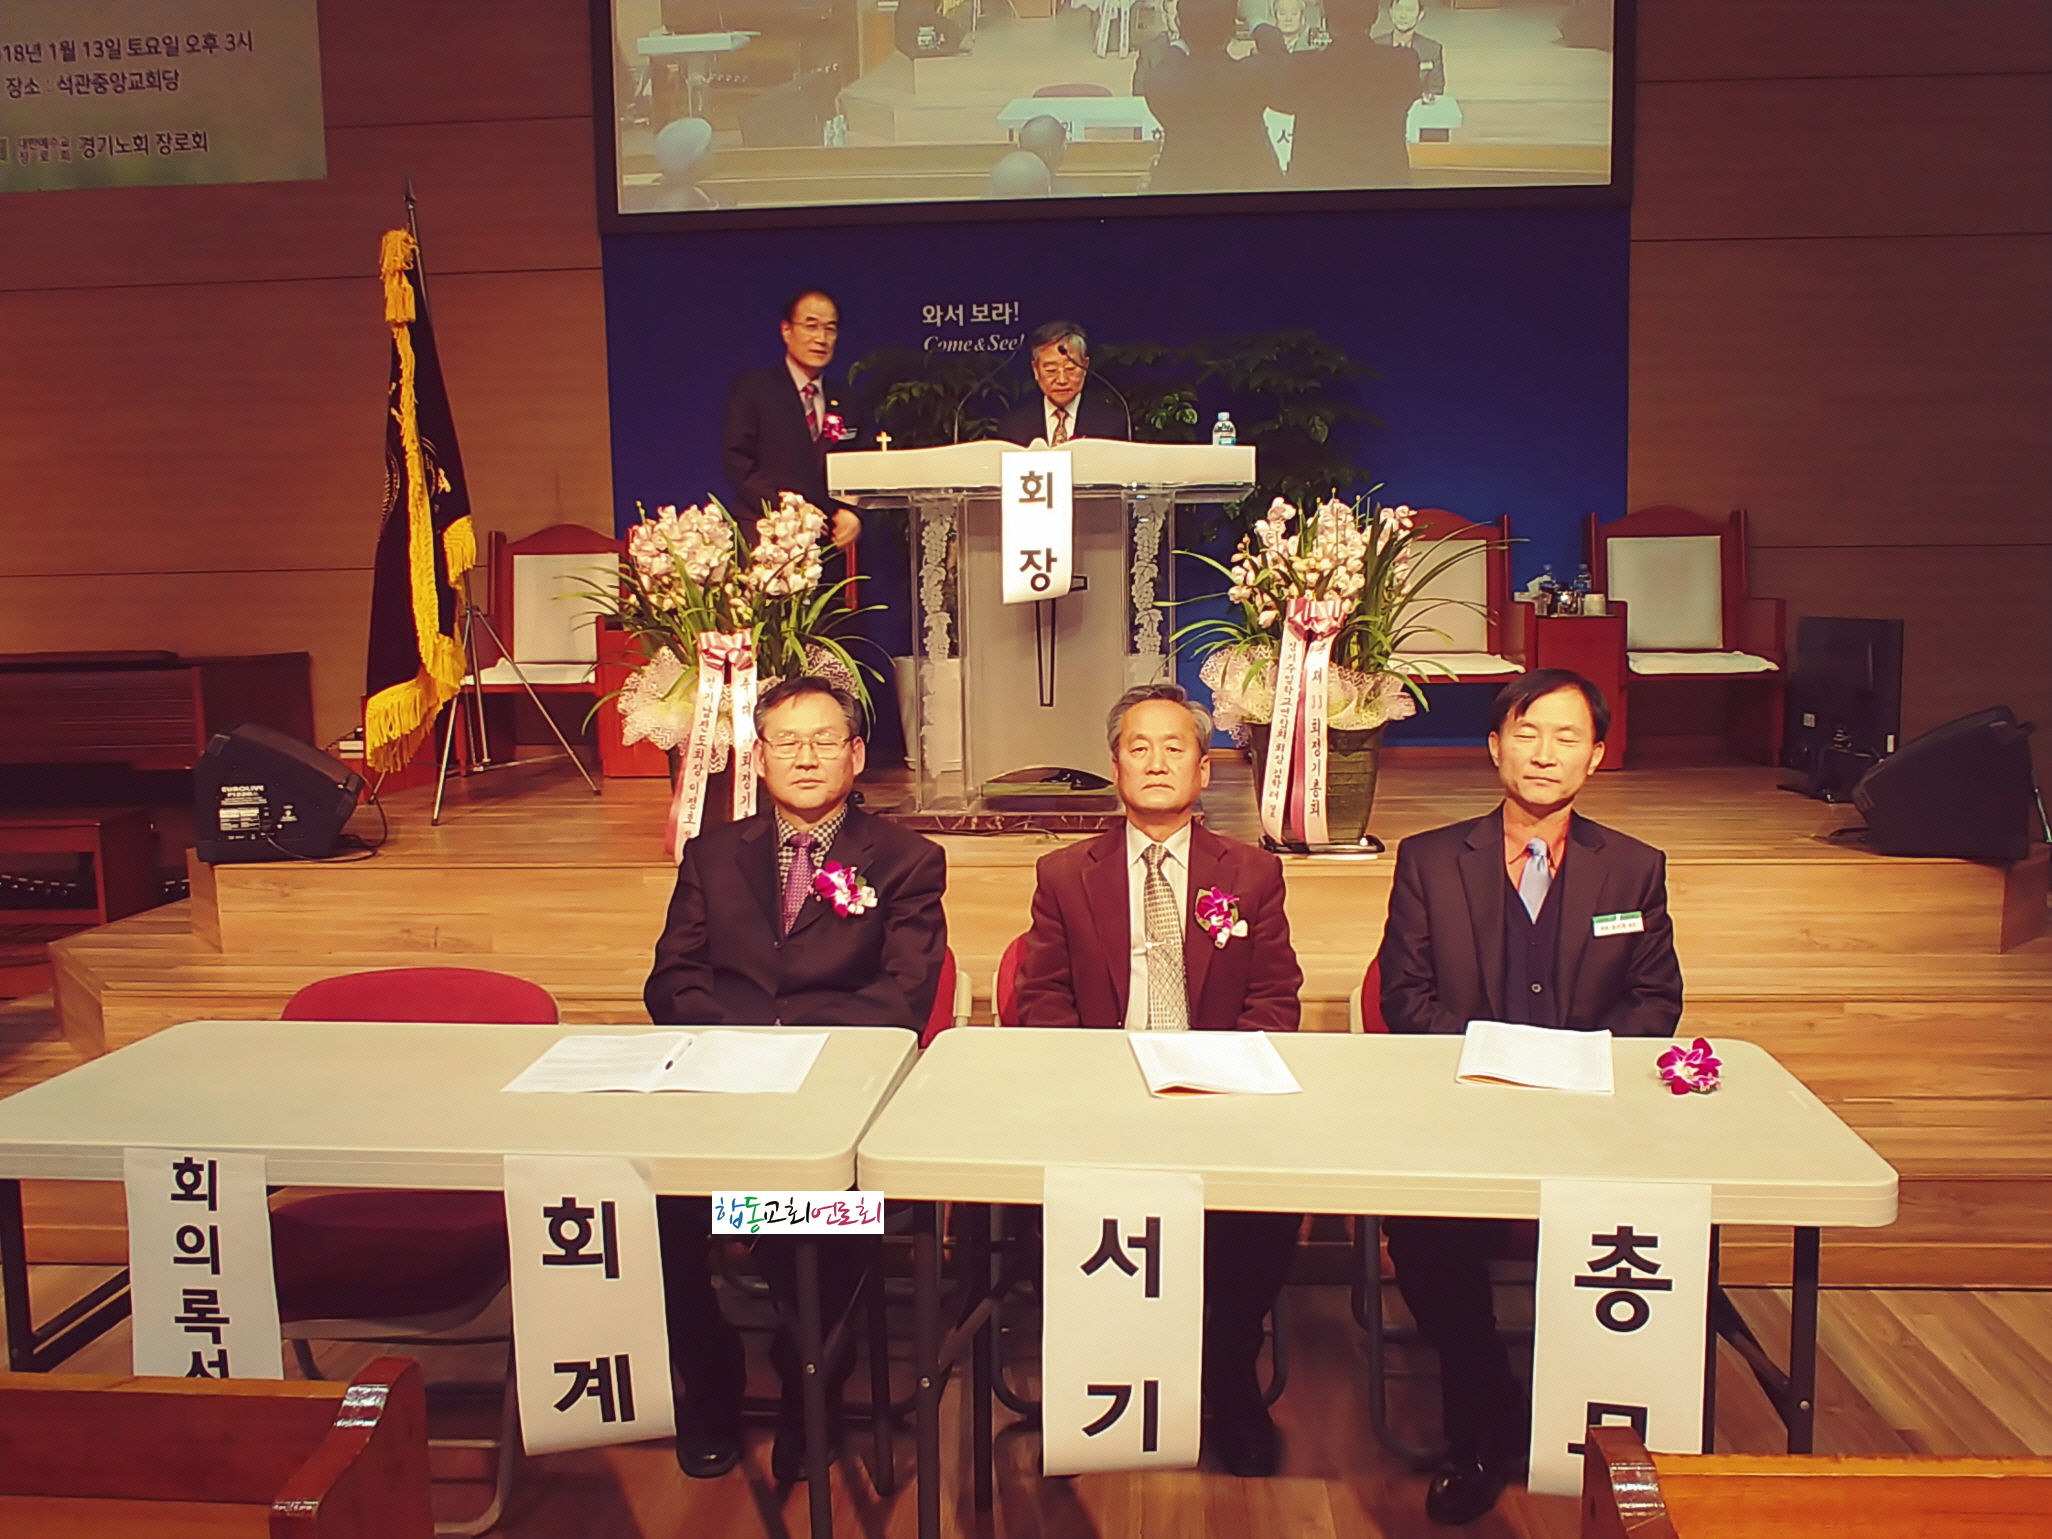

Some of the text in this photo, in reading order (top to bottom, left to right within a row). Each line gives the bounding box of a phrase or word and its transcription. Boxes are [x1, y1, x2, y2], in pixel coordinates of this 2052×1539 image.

[0, 30, 253, 63] 18년 1월 13일 토요일 오후 3시
[5, 76, 41, 99] 장소
[57, 69, 180, 96] 석관중앙교회당
[79, 134, 149, 159] 경기노회
[155, 131, 208, 155] 장로회
[922, 301, 1019, 327] 와서 보라!
[1018, 470, 1058, 592] 회장
[542, 1197, 636, 1423] 회계
[1079, 1215, 1162, 1452] 서기
